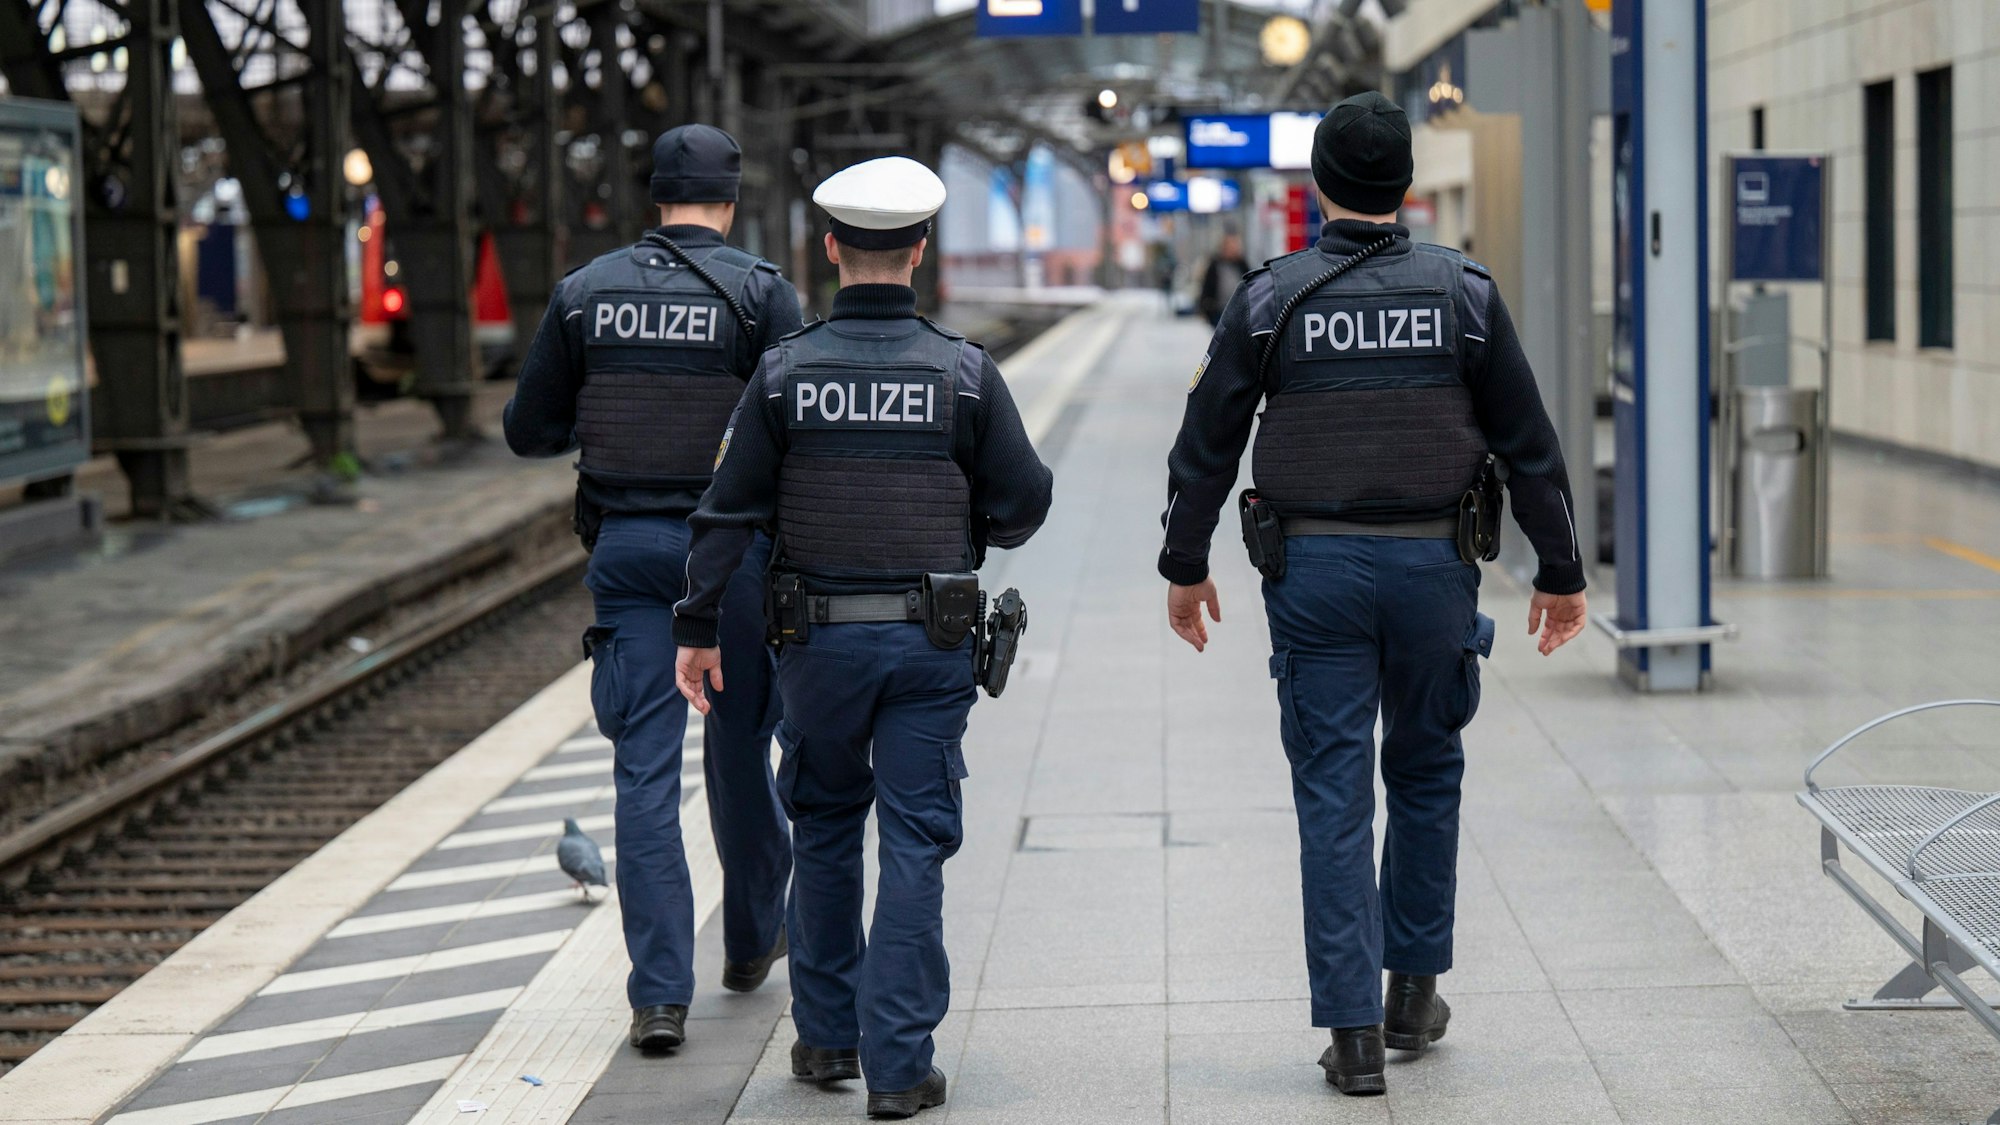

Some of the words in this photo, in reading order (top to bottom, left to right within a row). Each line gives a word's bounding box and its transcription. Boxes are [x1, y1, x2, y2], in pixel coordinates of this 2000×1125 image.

[595, 302, 717, 341] POLIZEI
[1304, 308, 1442, 352] POLIZEI
[796, 382, 934, 422] POLIZEI
